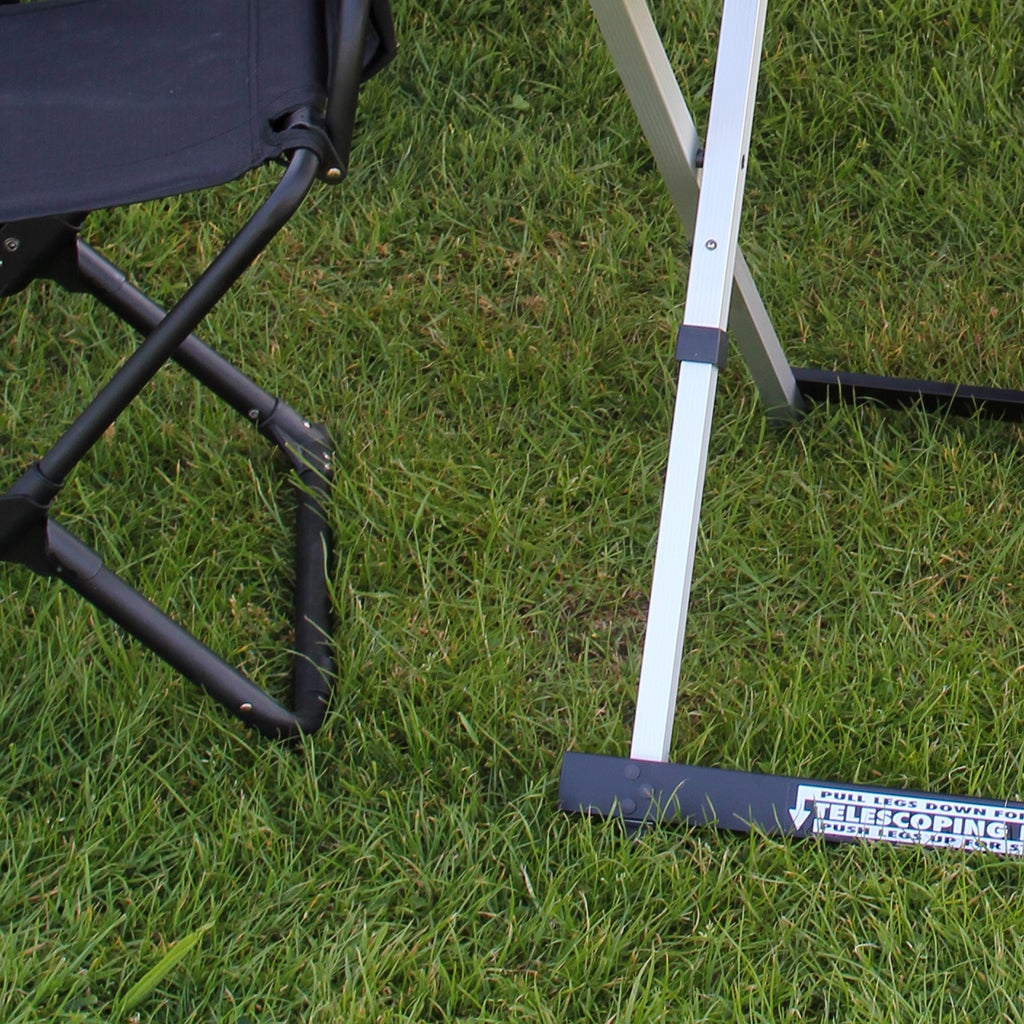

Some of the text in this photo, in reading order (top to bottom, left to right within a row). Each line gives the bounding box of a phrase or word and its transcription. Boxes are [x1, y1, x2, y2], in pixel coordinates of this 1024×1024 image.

[820, 790, 865, 803] PULL
[873, 796, 918, 808] LEGS
[925, 802, 986, 817] DOWN
[815, 801, 1009, 840] TELESCOPING
[823, 822, 870, 835] PUSH
[878, 829, 922, 842] LEGS
[930, 834, 957, 844] UP
[965, 838, 1001, 851] FOR
